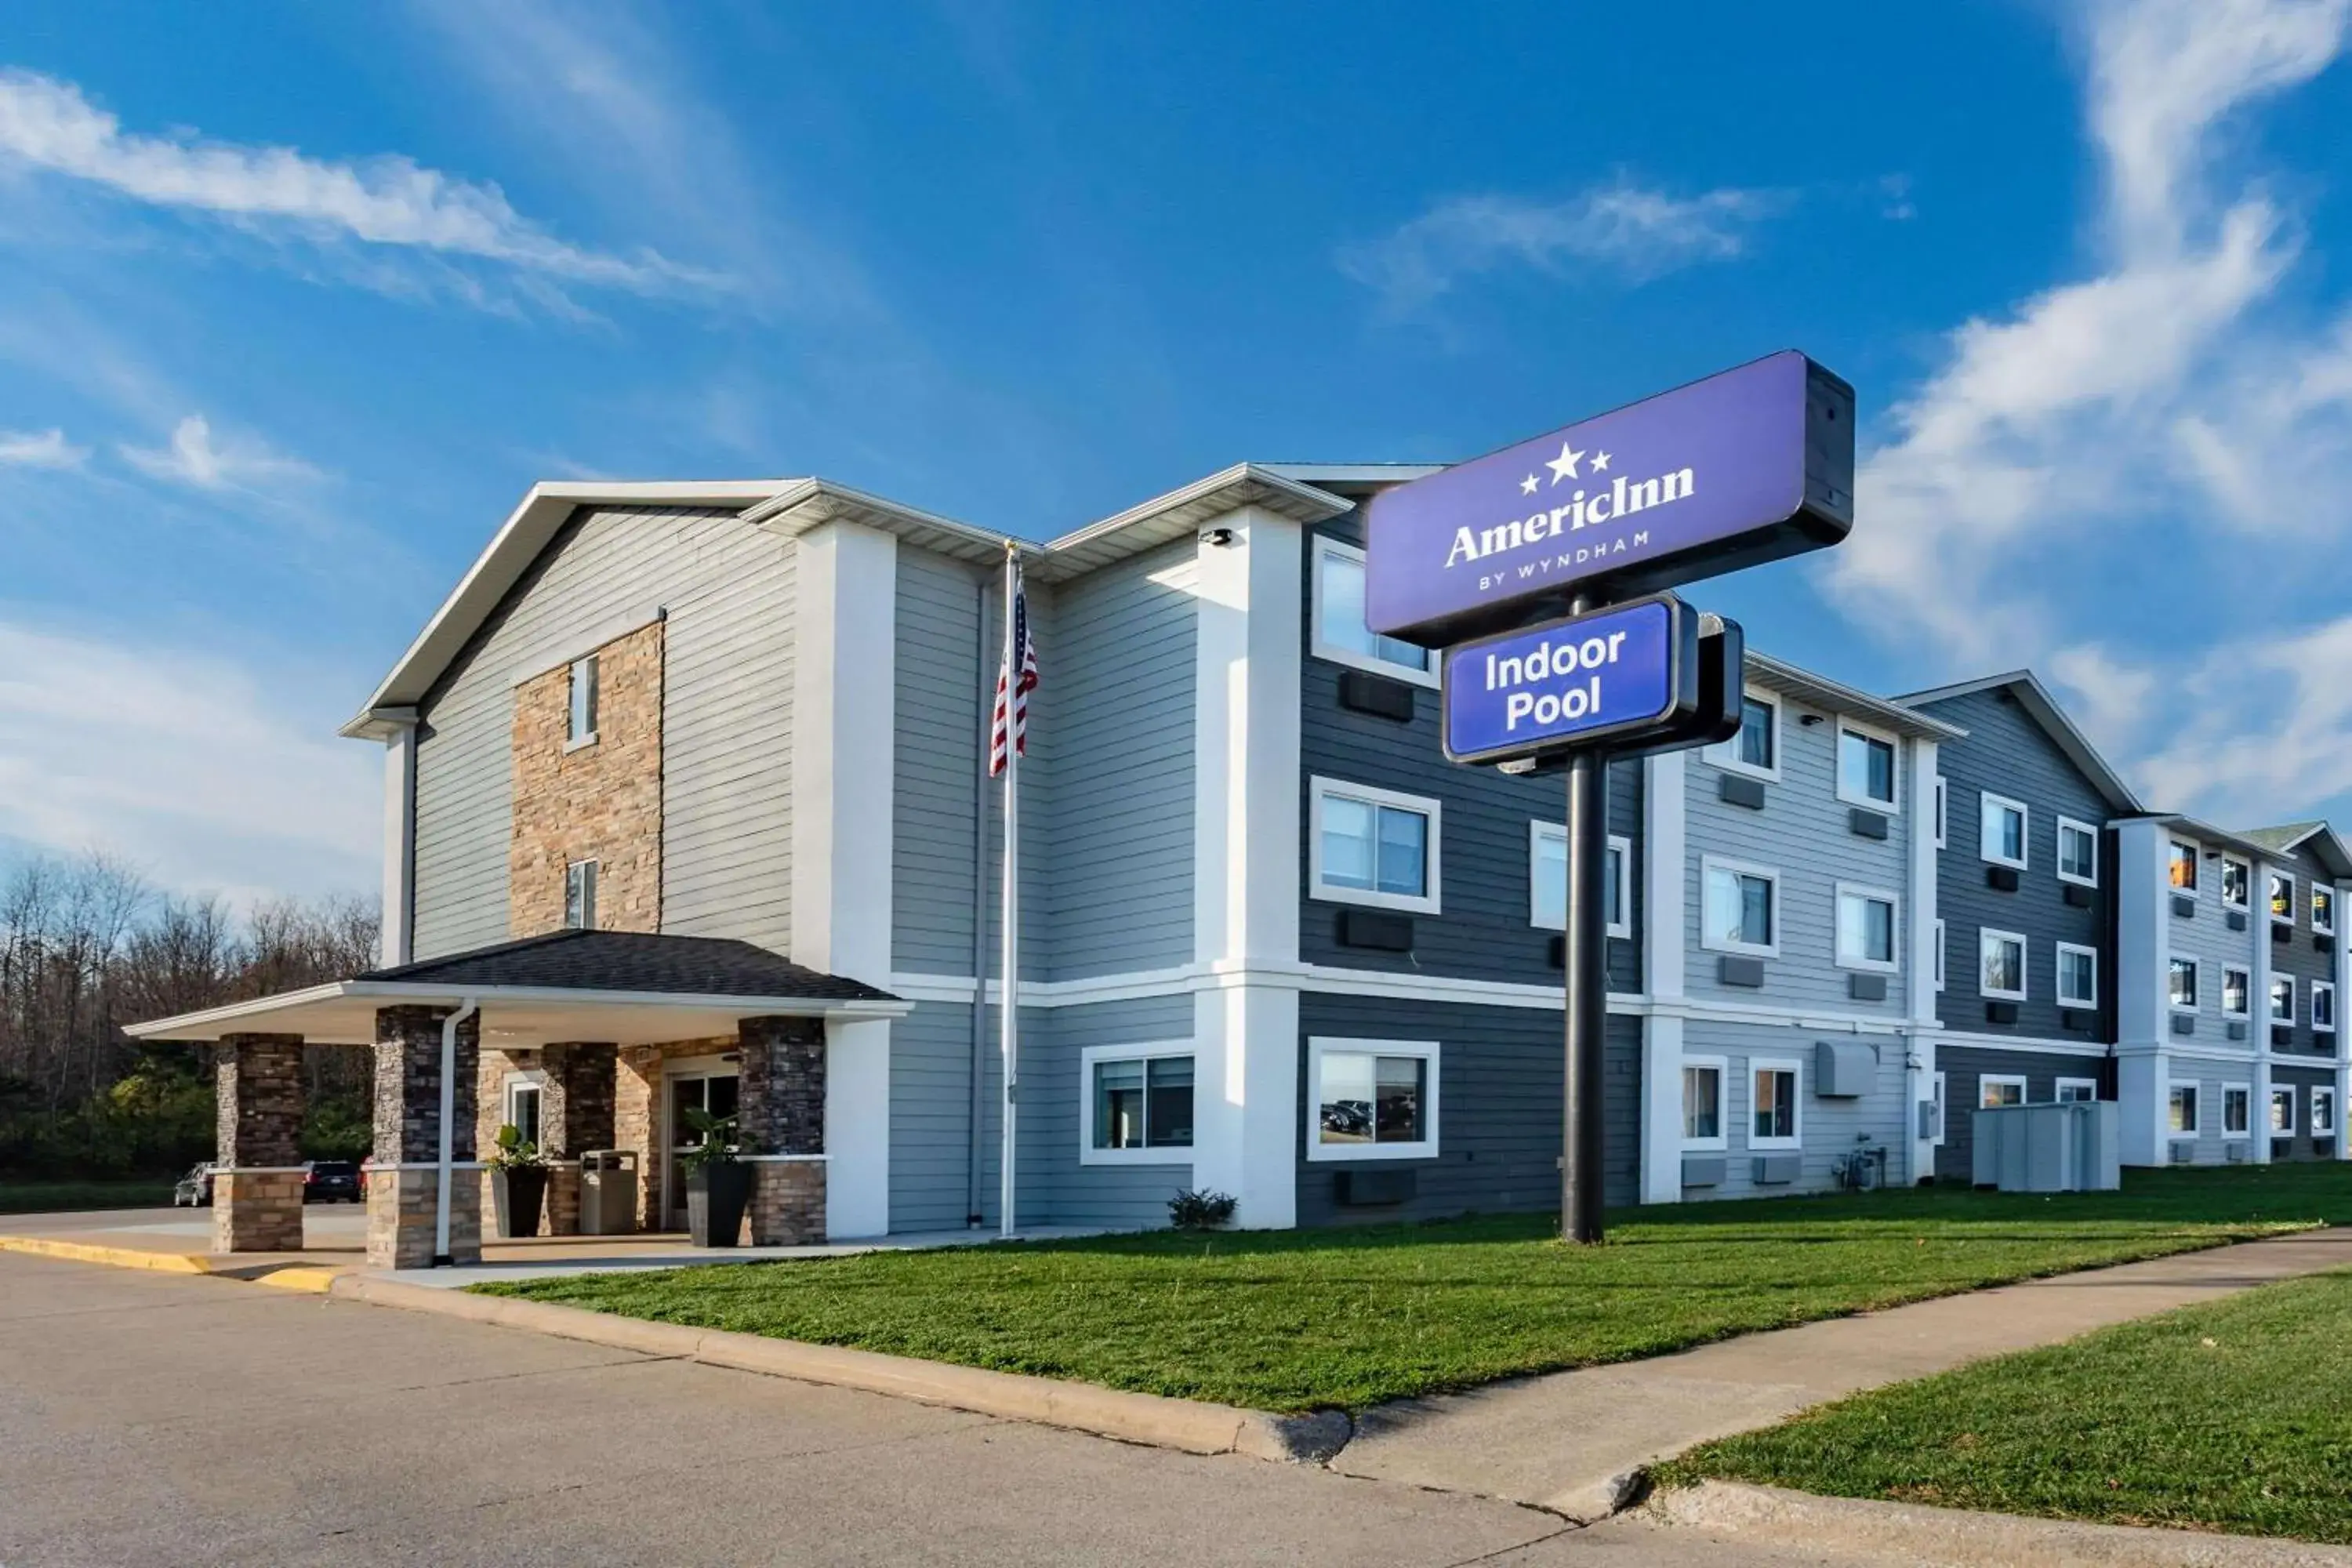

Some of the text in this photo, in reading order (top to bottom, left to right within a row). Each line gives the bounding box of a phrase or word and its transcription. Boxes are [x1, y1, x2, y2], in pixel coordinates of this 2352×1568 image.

[1443, 468, 1694, 568] AmericInn
[1479, 531, 1648, 590] BY WYNDHAM
[1486, 631, 1626, 691] Indoor
[1508, 677, 1600, 731] Pool
